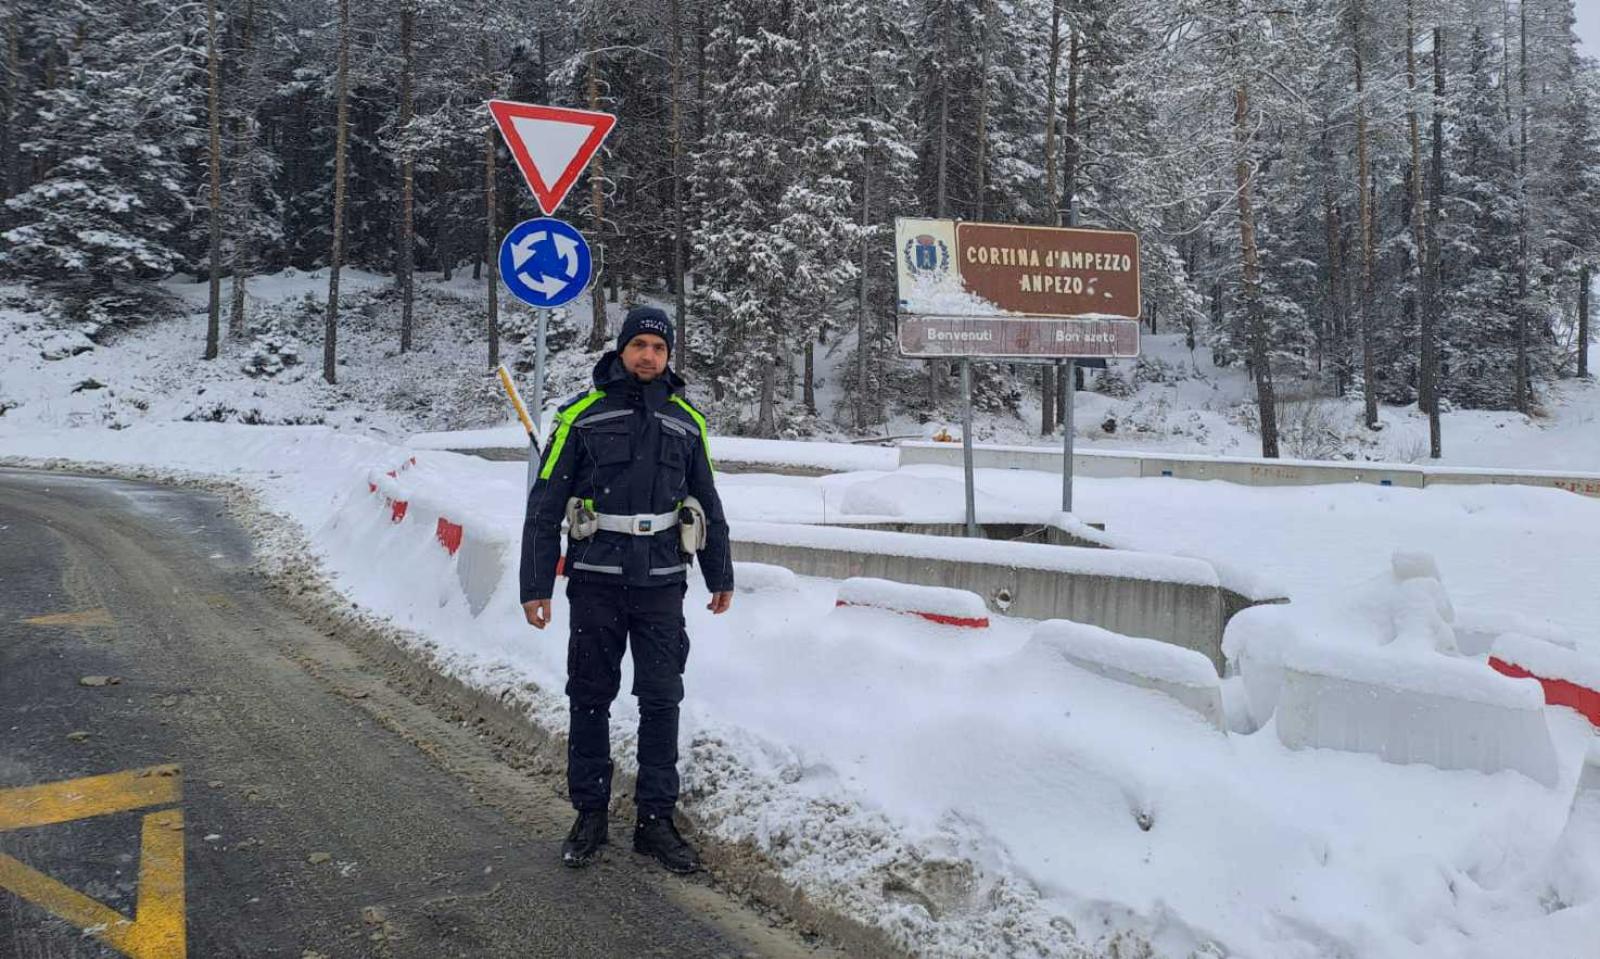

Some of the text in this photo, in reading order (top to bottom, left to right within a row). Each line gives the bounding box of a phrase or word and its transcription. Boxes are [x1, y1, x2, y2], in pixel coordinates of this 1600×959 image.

[966, 246, 1131, 272] CORTINA d'AMPEZZO
[1021, 274, 1083, 294] ANPEZO
[927, 328, 992, 342] Benvenuti
